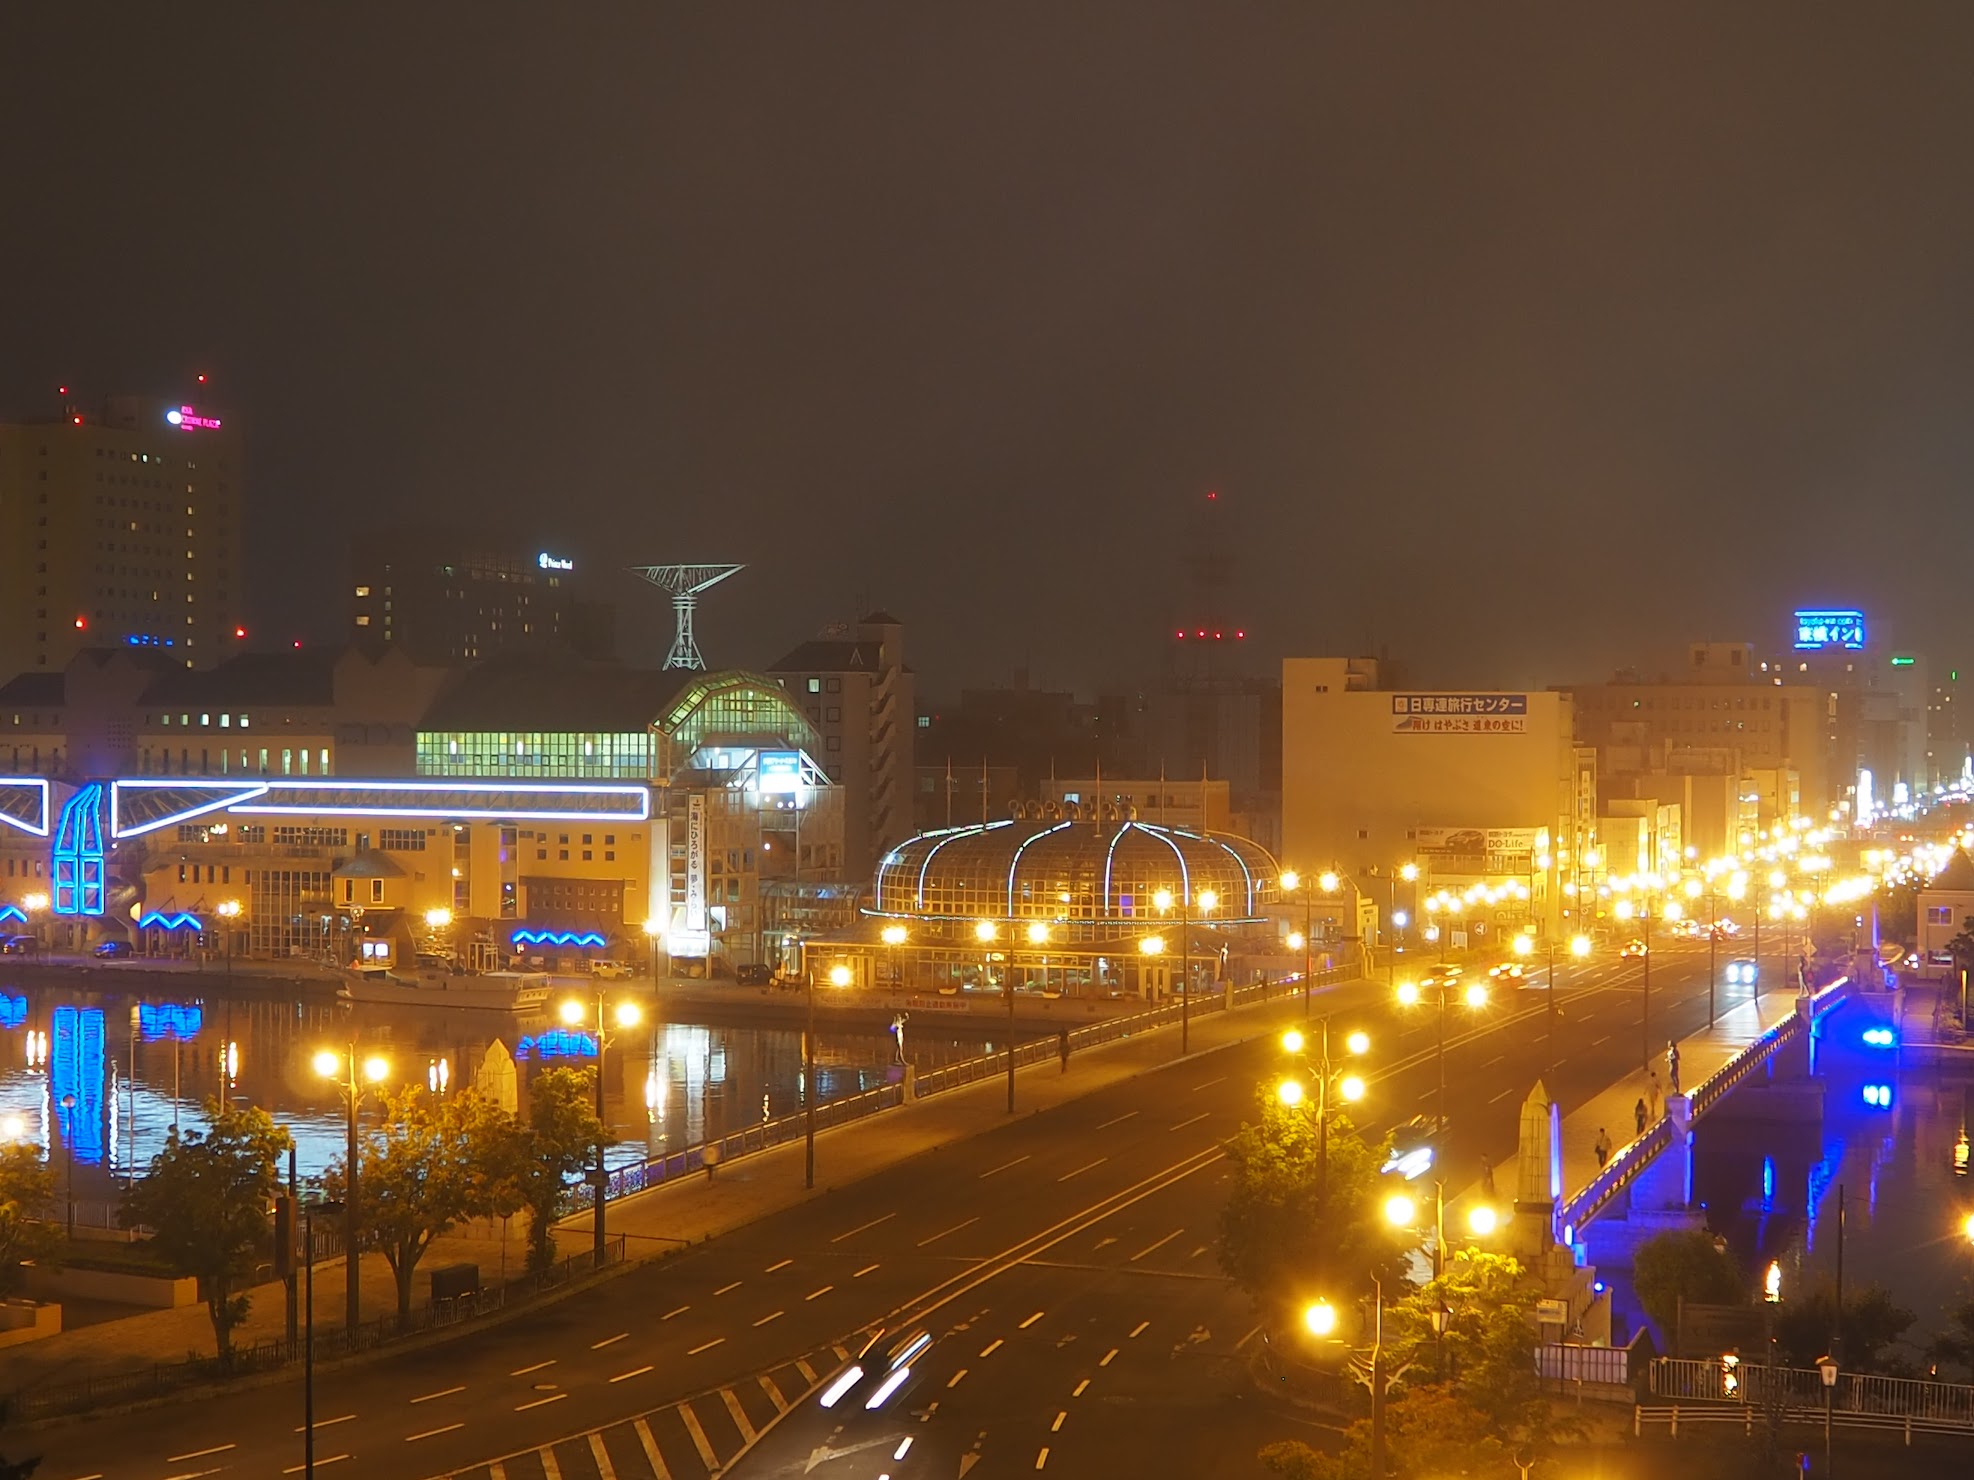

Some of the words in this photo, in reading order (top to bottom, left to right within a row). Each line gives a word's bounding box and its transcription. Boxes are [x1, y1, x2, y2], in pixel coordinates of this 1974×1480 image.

[1410, 697, 1523, 713] 日専連旅行センター
[1434, 719, 1470, 732] はやぶさ
